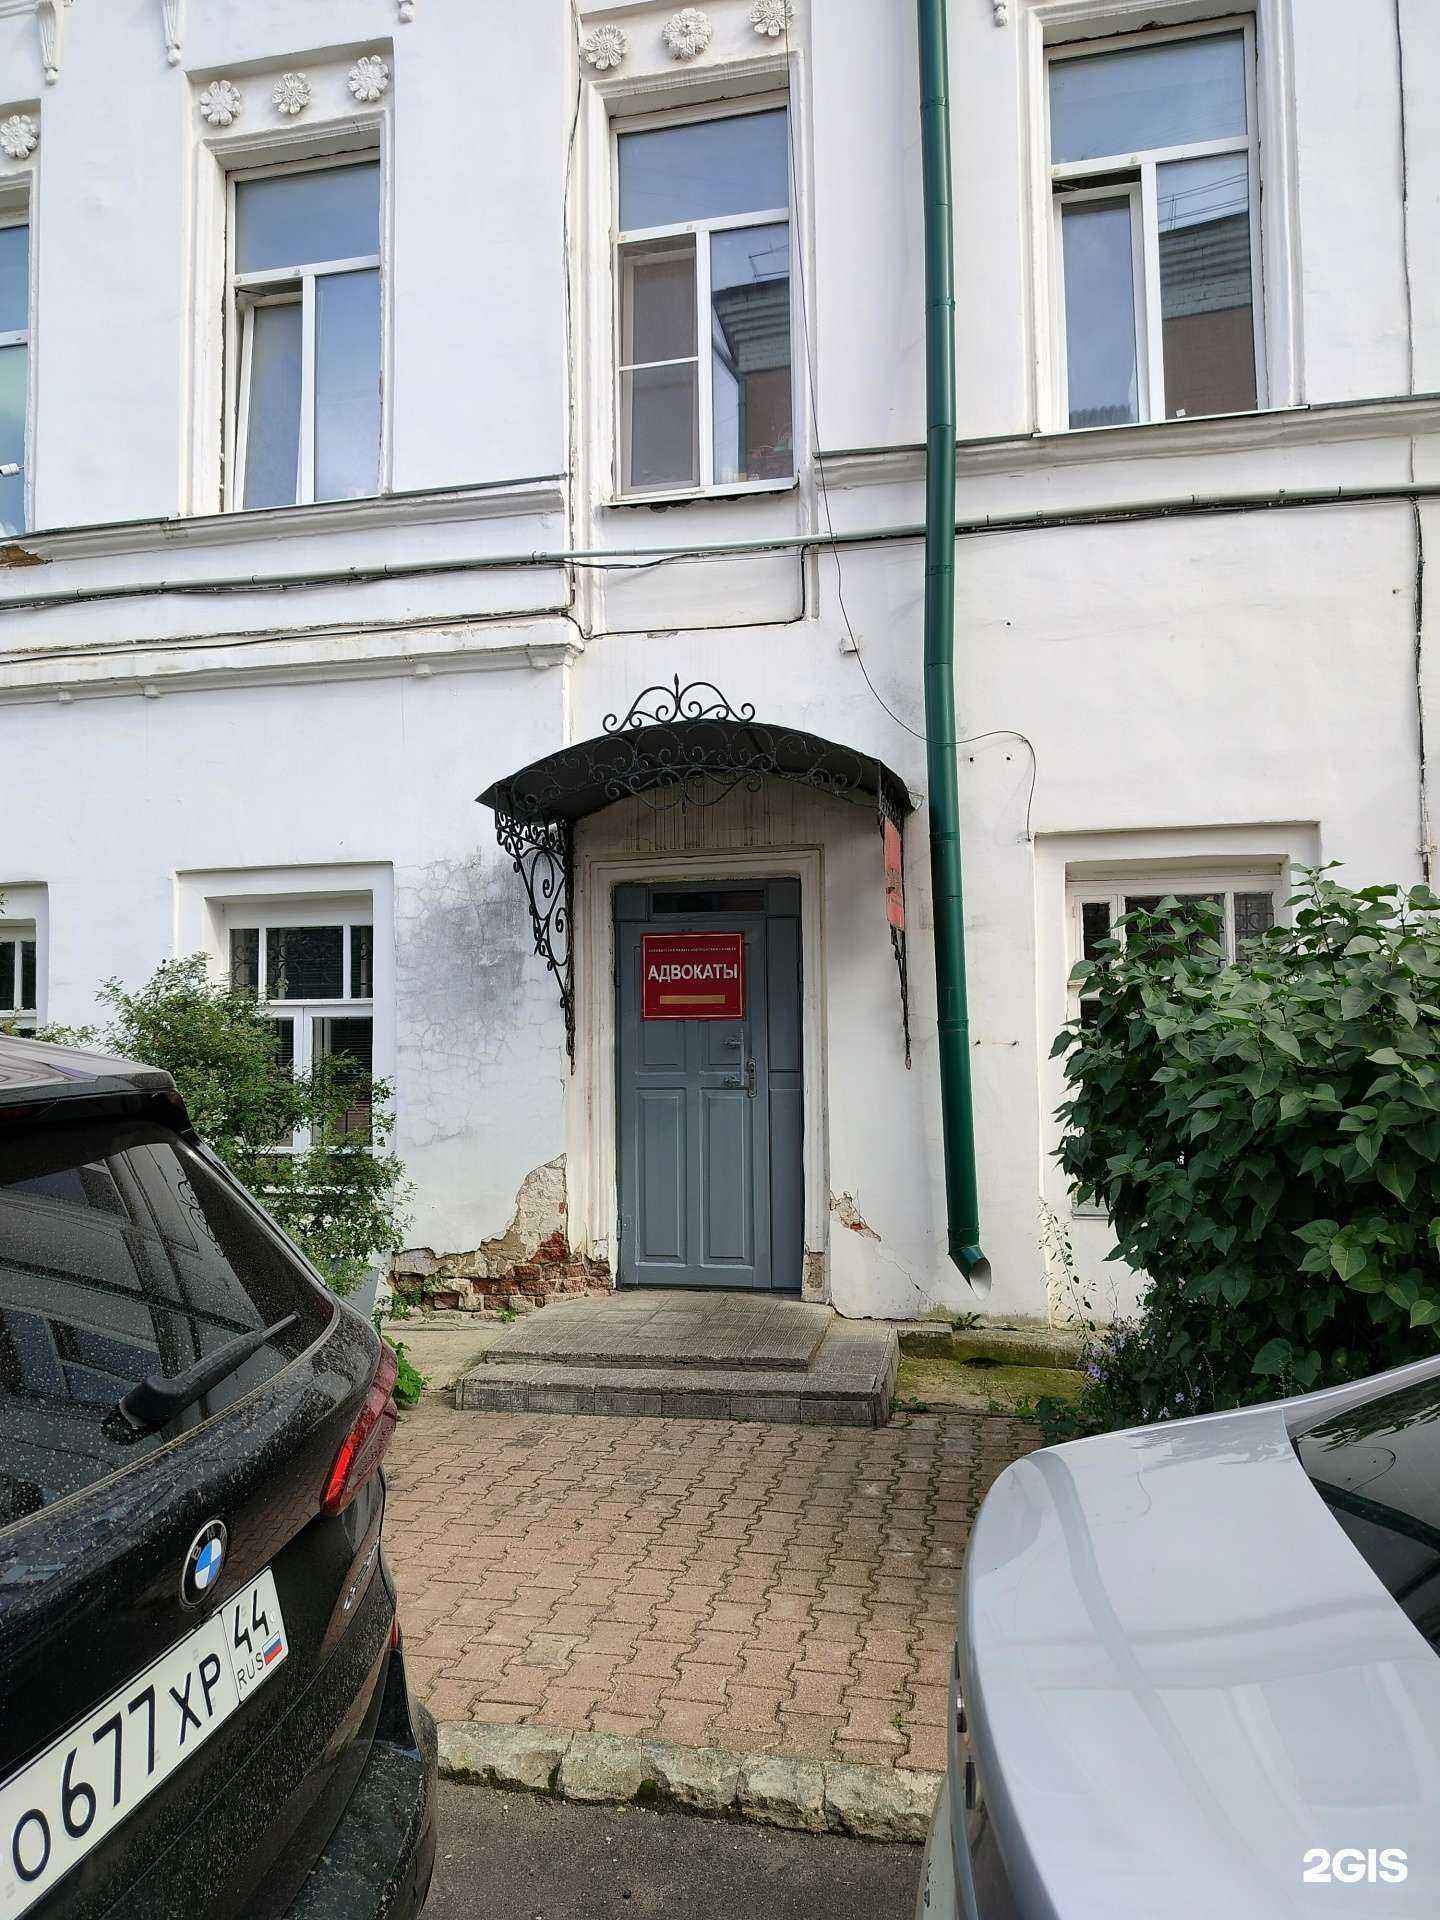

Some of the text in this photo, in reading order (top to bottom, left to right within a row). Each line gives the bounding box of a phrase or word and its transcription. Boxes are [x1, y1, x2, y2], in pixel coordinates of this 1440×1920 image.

[648, 963, 738, 983] АДВОКАТЫ
[234, 1588, 270, 1654] 44
[237, 1652, 264, 1689] RUS
